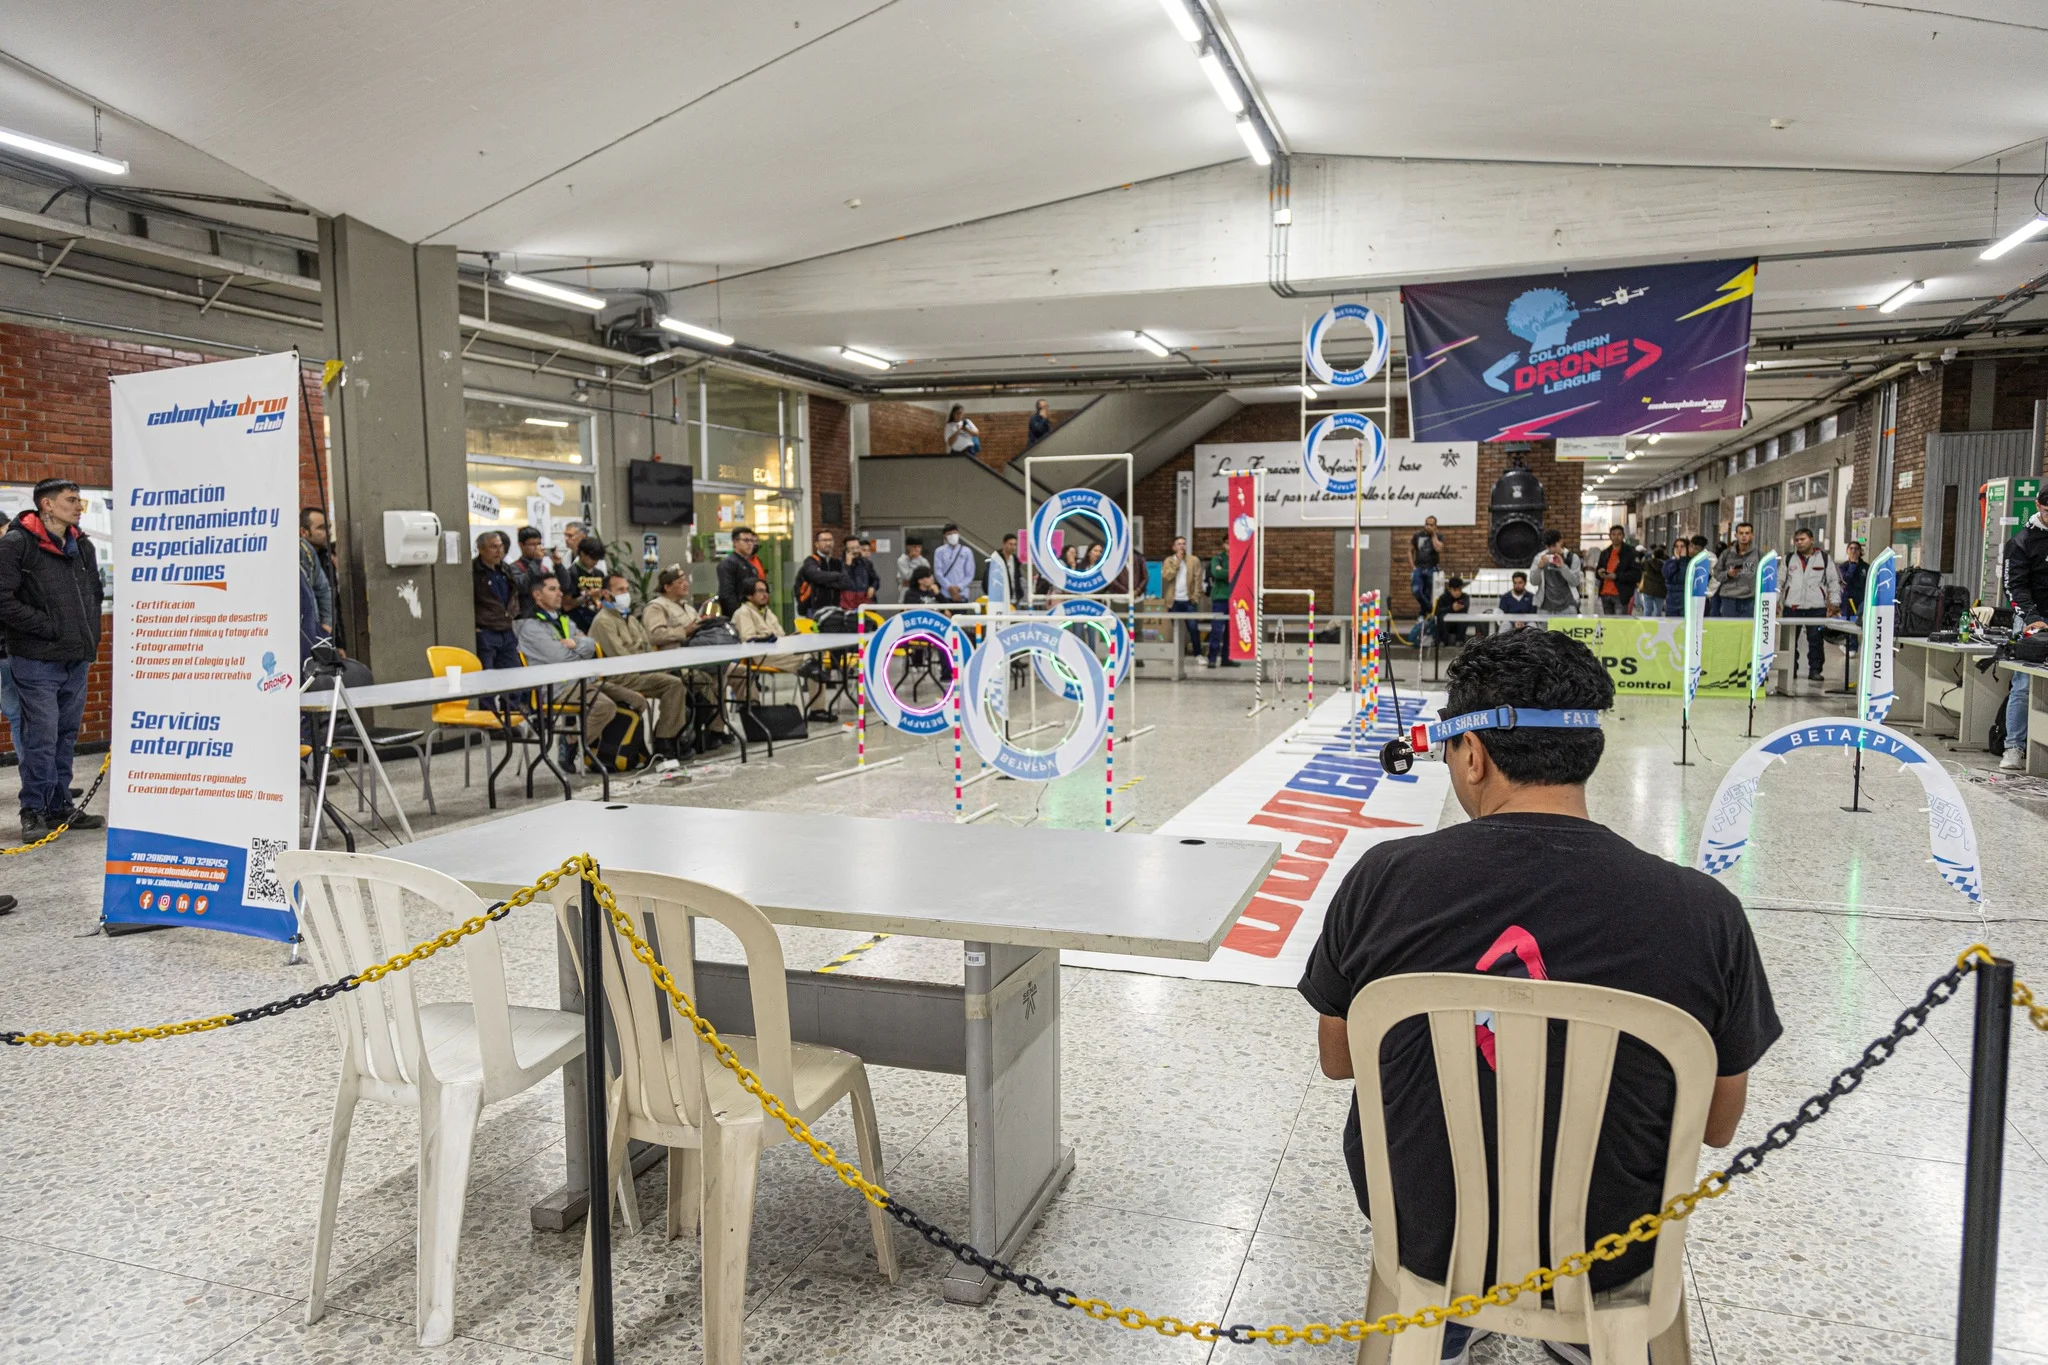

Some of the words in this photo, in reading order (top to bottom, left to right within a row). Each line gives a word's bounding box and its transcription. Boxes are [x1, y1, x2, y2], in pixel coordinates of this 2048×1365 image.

[1528, 333, 1610, 365] COLOMBIAN
[1514, 339, 1628, 391] DRONE
[1543, 370, 1601, 394] LEAGUE
[147, 394, 288, 428] colombiadron
[130, 484, 225, 506] Formación
[131, 506, 267, 531] entrenamiento
[271, 508, 279, 528] y
[131, 533, 268, 559] especialización
[131, 566, 158, 582] en
[161, 563, 225, 582] drones
[175, 614, 189, 623] del
[191, 615, 216, 625] riesgo
[218, 614, 228, 622] de
[229, 613, 268, 622] desastres
[904, 616, 947, 632] BETAFPV
[136, 656, 170, 665] Drones
[184, 656, 192, 665] el
[194, 656, 224, 667] Colegio
[231, 656, 239, 665] la
[1602, 656, 1638, 675] PS
[136, 670, 170, 679] Drones
[172, 672, 192, 681] para
[194, 672, 210, 680] uso
[211, 671, 251, 680] recreativo
[264, 674, 287, 691] DRONE
[1618, 679, 1671, 690] control
[131, 710, 221, 731] Servicios
[901, 715, 944, 729] BETAFPV
[1436, 722, 1452, 738] FAT
[1455, 712, 1489, 730] SHARK
[1563, 711, 1593, 725] FAT
[131, 737, 234, 759] enterprise
[1790, 729, 1904, 754] BETAFPV
[128, 770, 202, 782] Entrenamientos
[203, 774, 247, 784] regionales
[169, 785, 235, 798] departamentos
[258, 790, 284, 802] Drones
[131, 852, 146, 861] 310
[136, 877, 219, 891] www.colombiadron.club
